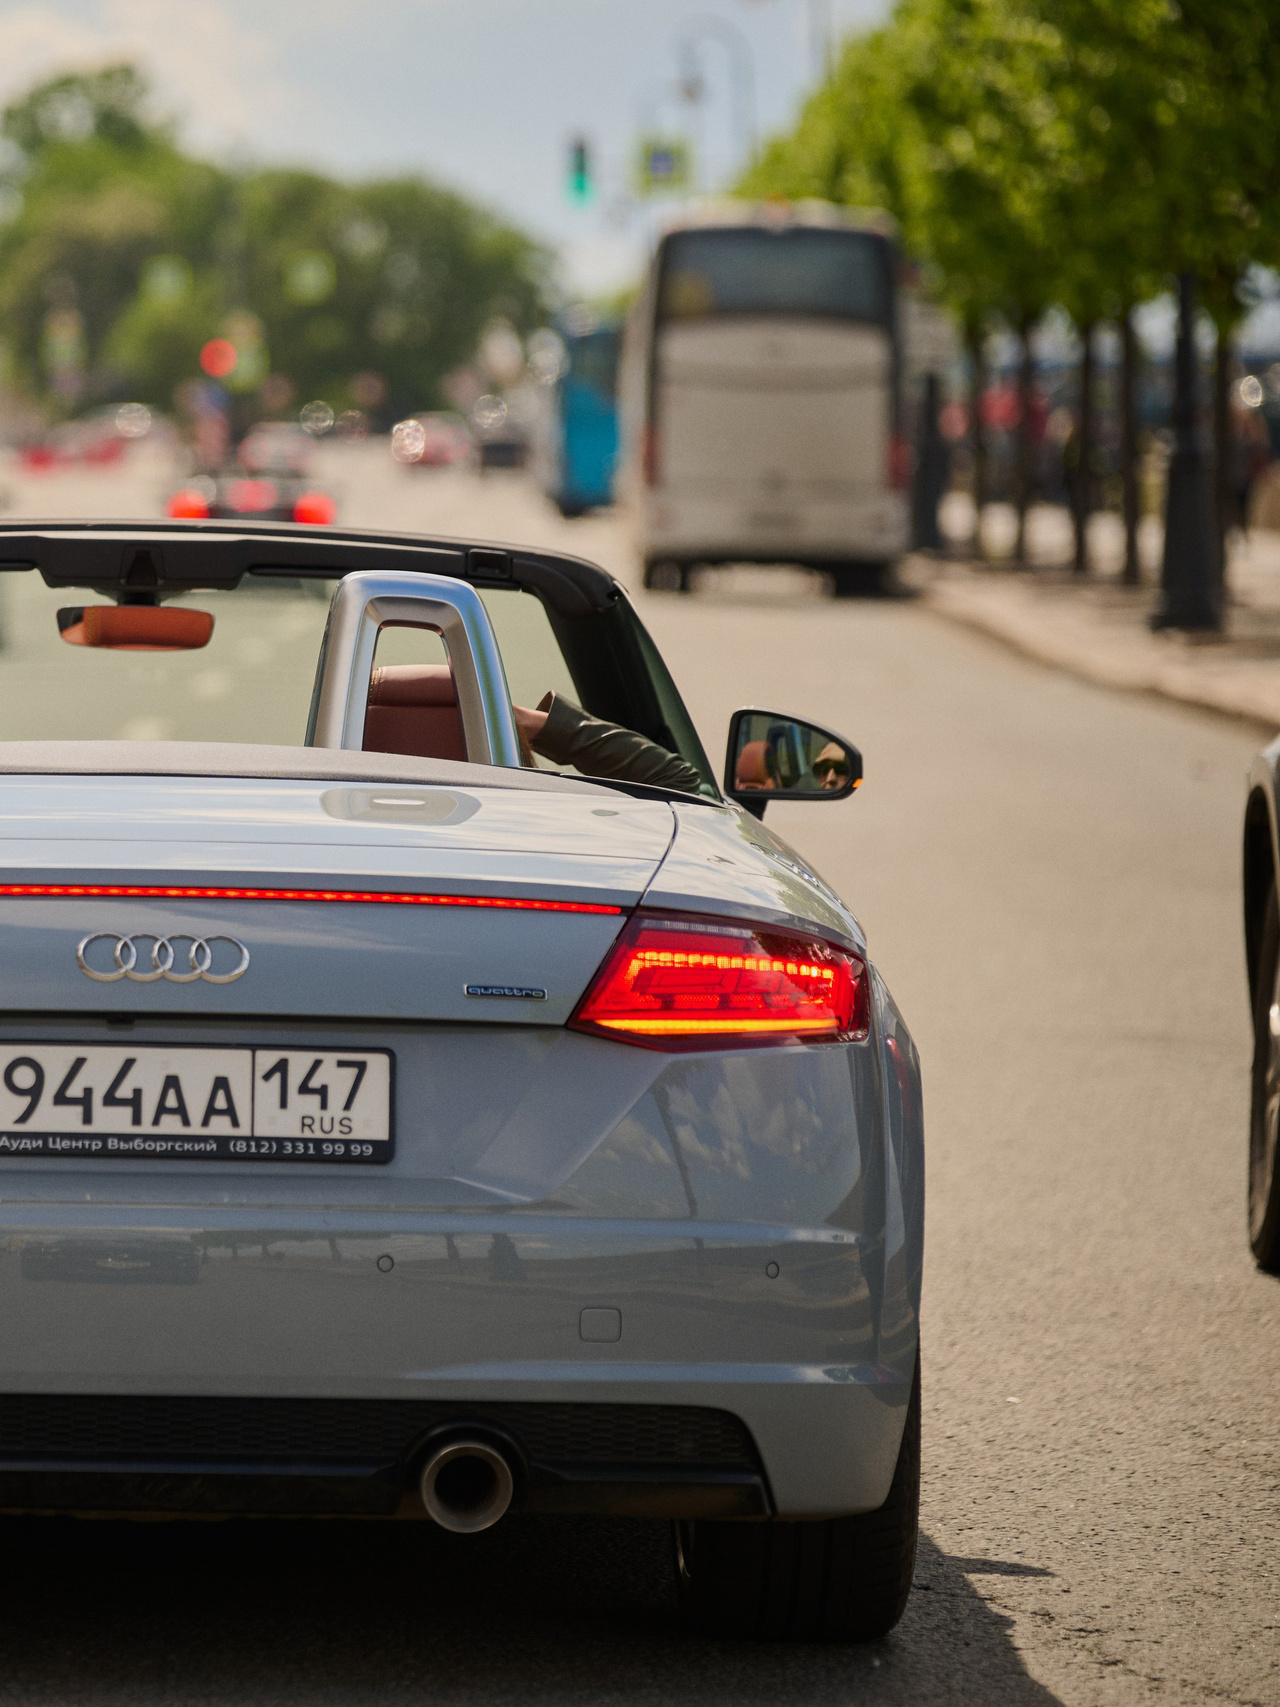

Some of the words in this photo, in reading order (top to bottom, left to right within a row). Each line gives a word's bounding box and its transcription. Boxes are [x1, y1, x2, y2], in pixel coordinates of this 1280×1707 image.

[468, 986, 544, 998] quattro
[261, 1058, 367, 1111] 147
[301, 1115, 353, 1135] RUS
[48, 1137, 102, 1151] Центр
[107, 1138, 218, 1153] Выборгский
[229, 1140, 277, 1154] (812)
[283, 1141, 316, 1155] 331
[322, 1142, 346, 1156] 99
[350, 1143, 373, 1157] 99
